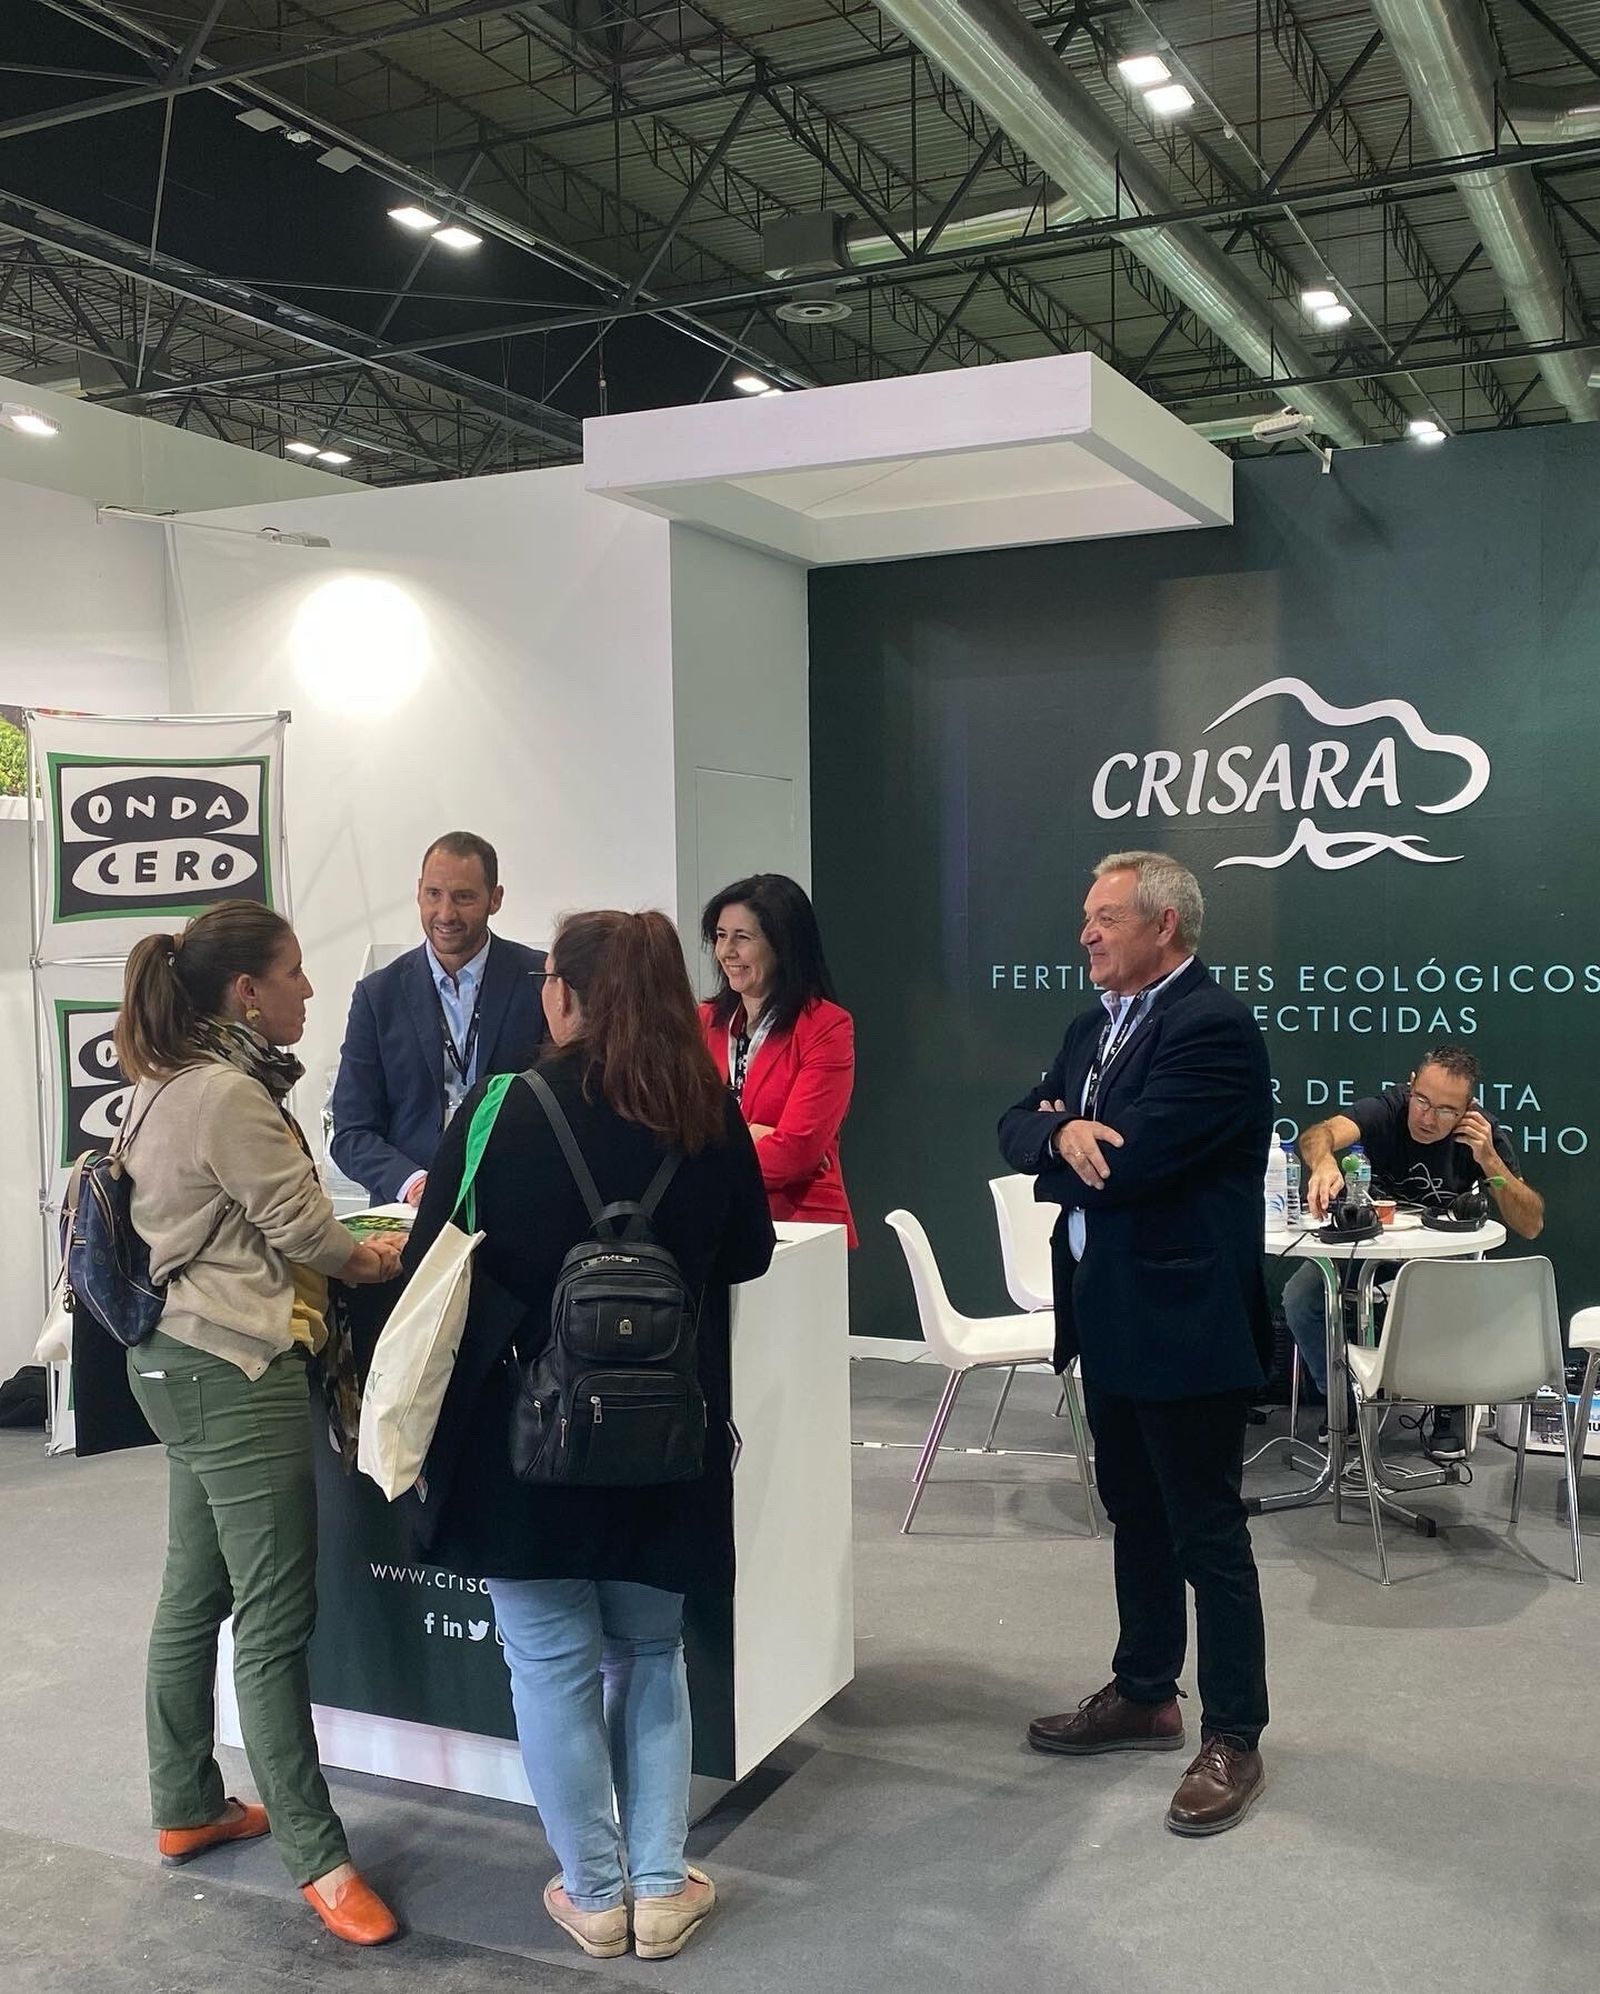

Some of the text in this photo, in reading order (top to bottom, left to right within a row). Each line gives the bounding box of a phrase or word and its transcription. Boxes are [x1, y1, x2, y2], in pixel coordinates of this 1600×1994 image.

[1092, 737, 1401, 819] CRISARA
[87, 795, 232, 823] ONDA
[98, 851, 234, 885] CERO
[1300, 957, 1600, 993] ECOLÓGICOS
[1253, 1005, 1478, 1034] ECTICIDAS
[1307, 1079, 1354, 1106] DE
